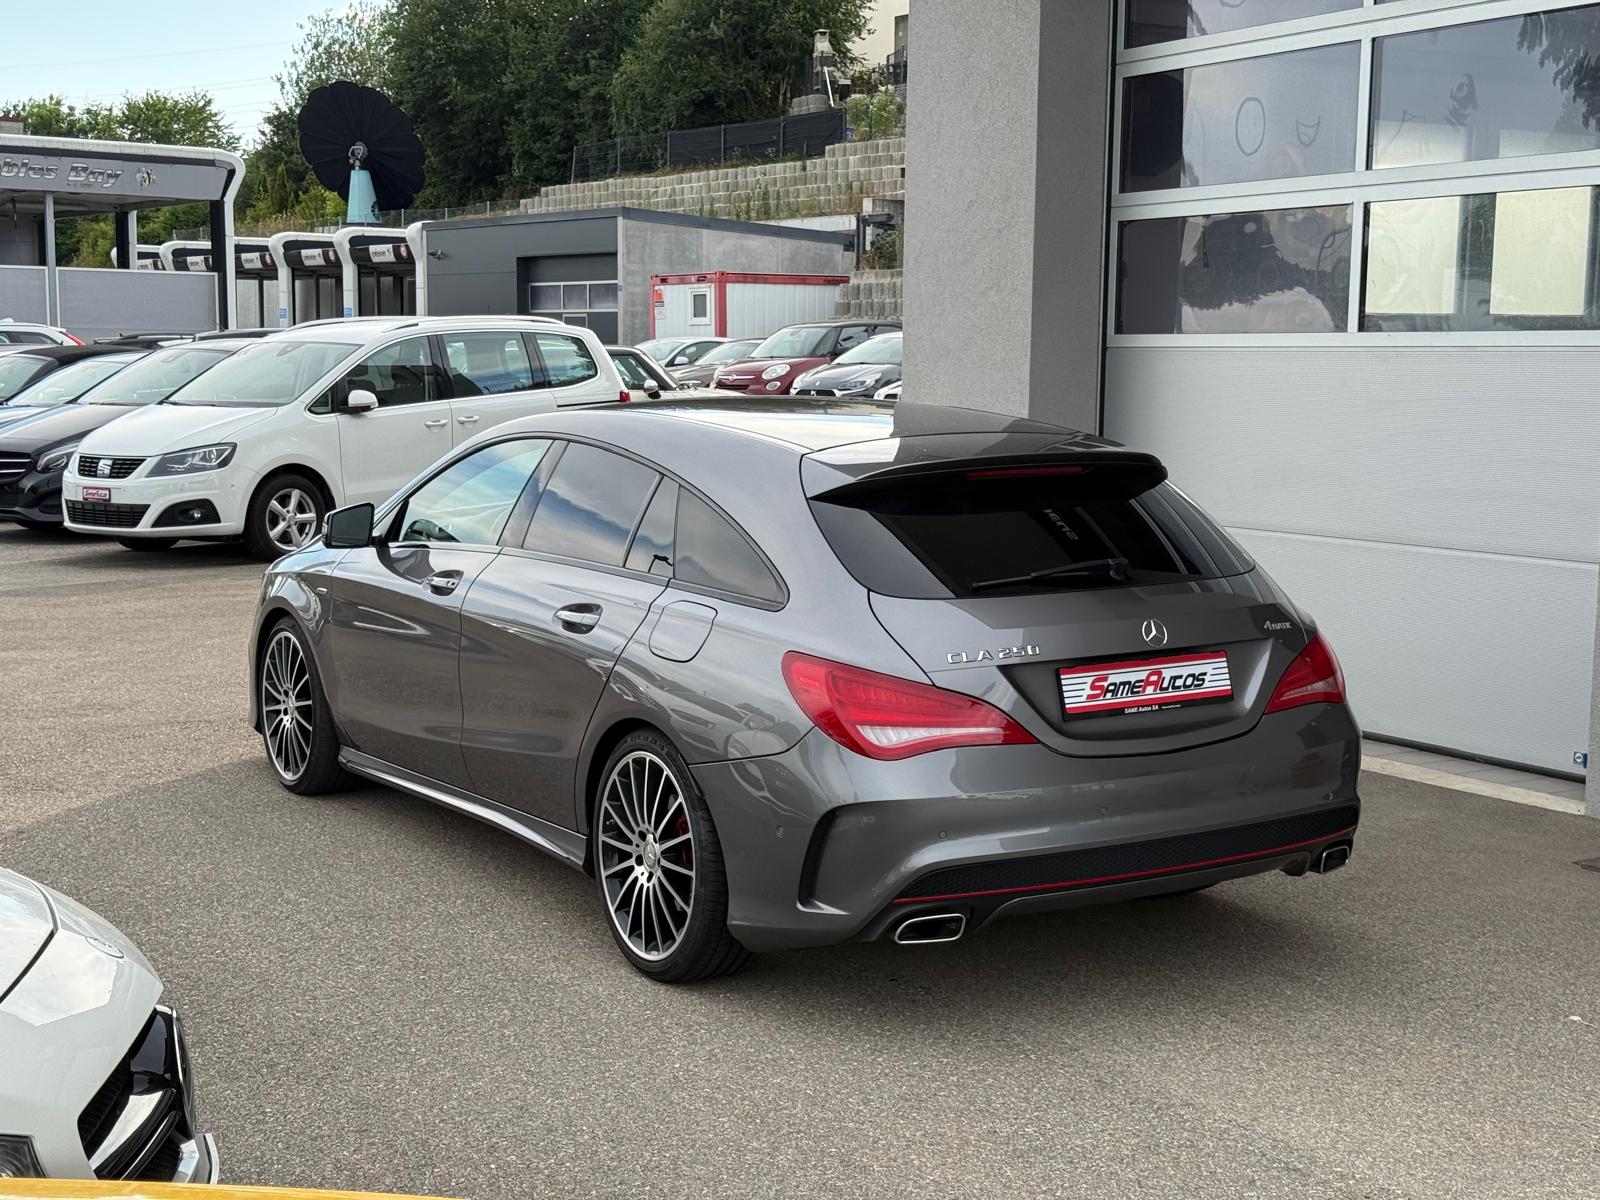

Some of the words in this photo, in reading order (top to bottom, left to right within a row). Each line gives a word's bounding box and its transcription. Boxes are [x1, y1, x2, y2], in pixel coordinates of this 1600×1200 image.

[0, 158, 59, 179] bles
[67, 162, 124, 188] Bay
[946, 649, 994, 664] CLA
[998, 645, 1040, 660] 250
